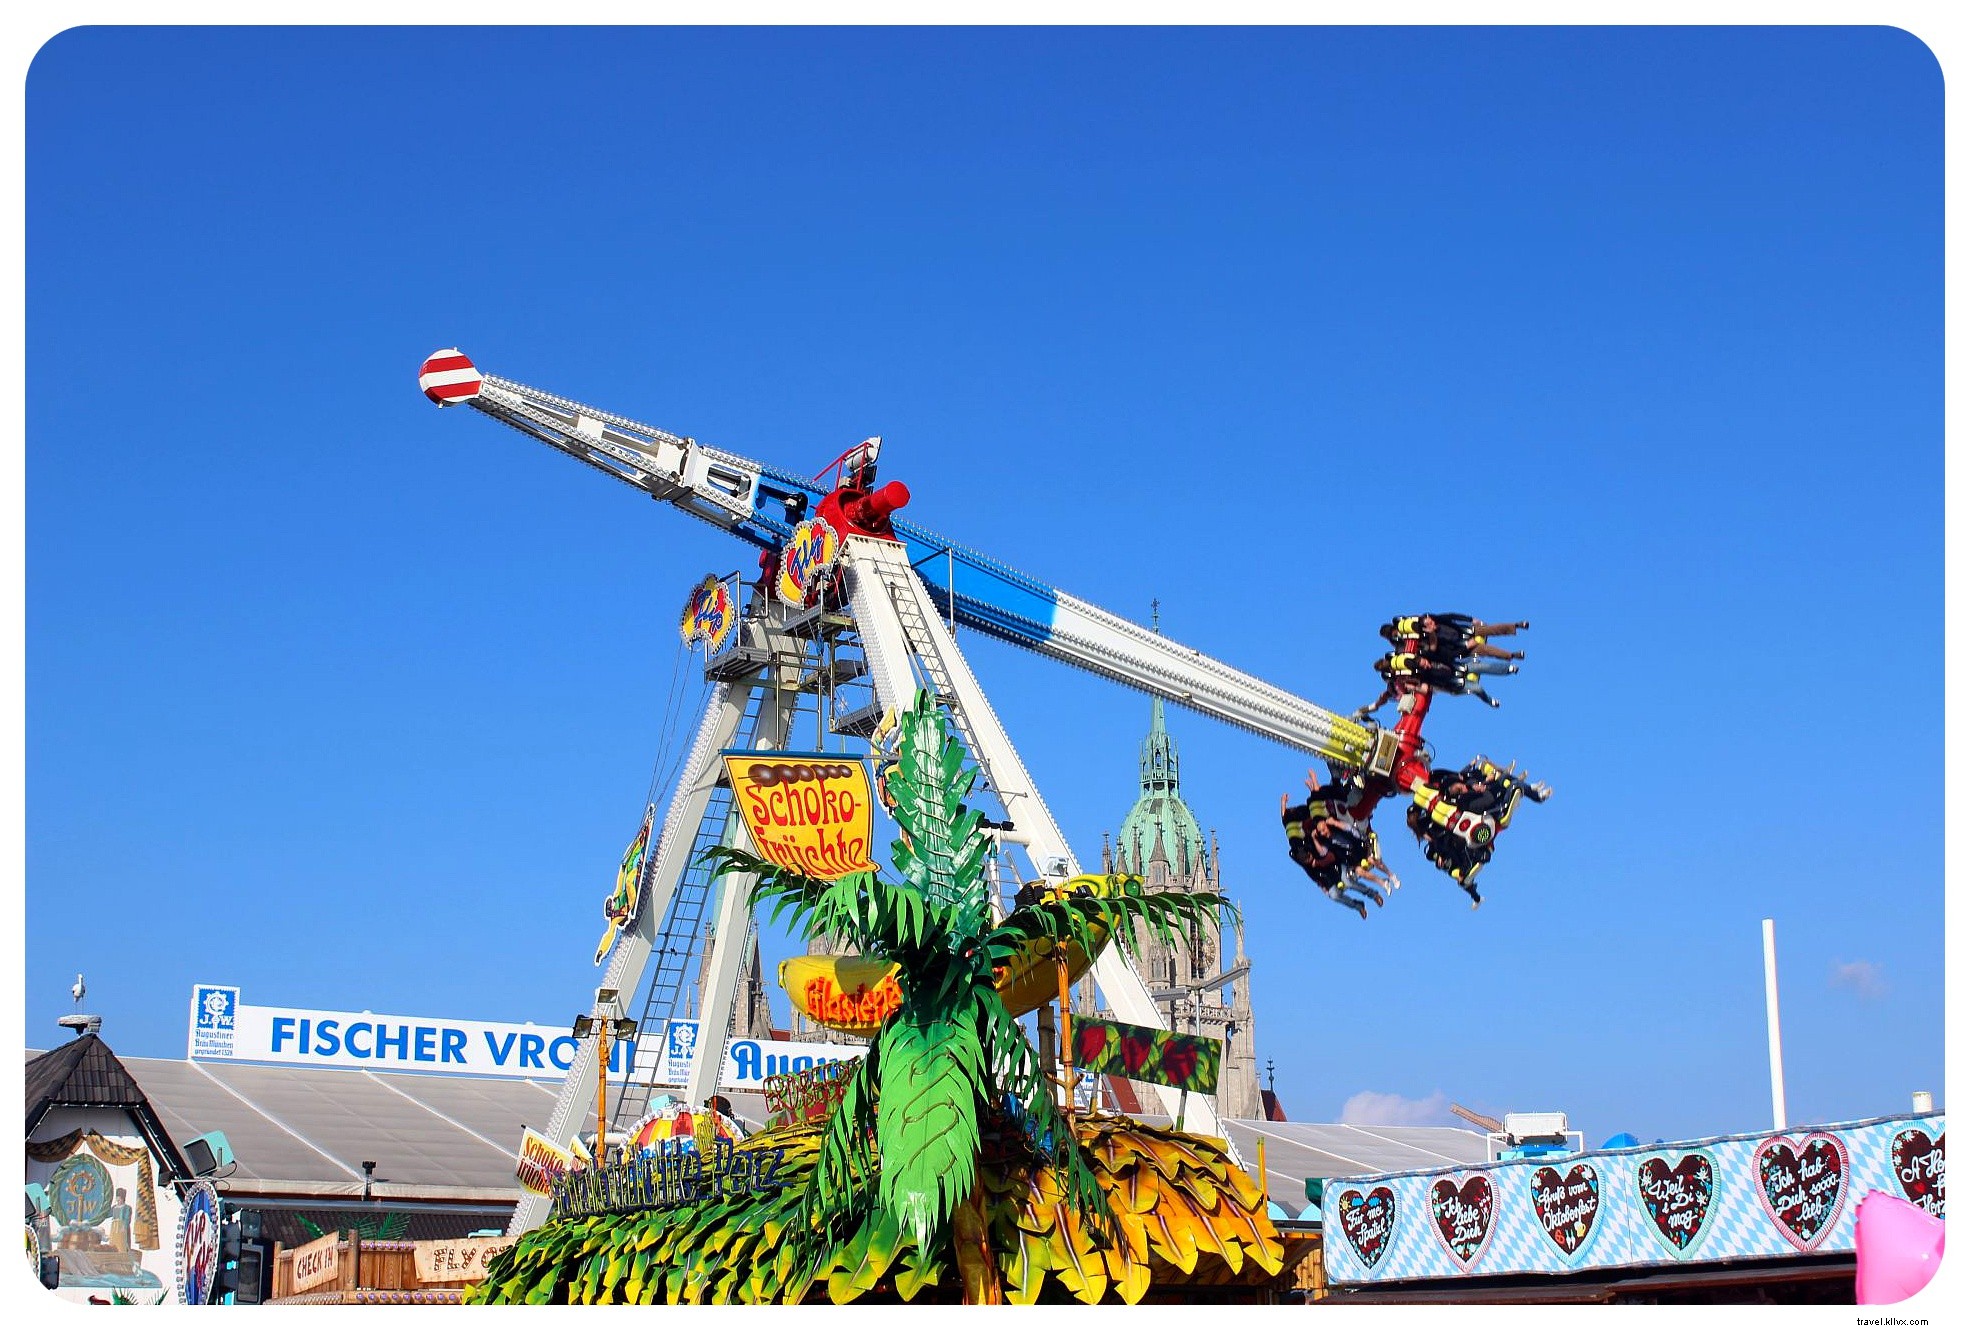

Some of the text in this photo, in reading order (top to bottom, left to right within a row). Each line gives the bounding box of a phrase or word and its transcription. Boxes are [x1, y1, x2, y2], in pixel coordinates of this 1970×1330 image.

[745, 777, 862, 827] Schoko-
[754, 826, 869, 877] früchte
[195, 1028, 234, 1040] Augustiner
[271, 1017, 467, 1064] FISCHER
[1771, 1156, 1825, 1193] Ich hab
[1901, 1155, 1921, 1182] A
[1537, 1182, 1589, 1212] Gruß vom
[1649, 1174, 1685, 1201] Weil
[1670, 1184, 1694, 1209] Di
[1775, 1185, 1808, 1216] Dich
[1346, 1204, 1384, 1231] Für mei
[1440, 1196, 1462, 1219] Ich
[1451, 1204, 1481, 1227] liebe
[1542, 1196, 1597, 1232] Oktoberfest
[1667, 1208, 1699, 1230] mog
[1796, 1195, 1826, 1221] lieb
[1450, 1223, 1483, 1245] Dich
[296, 1246, 334, 1279] CHECK IN
[433, 1247, 477, 1272] FLY
